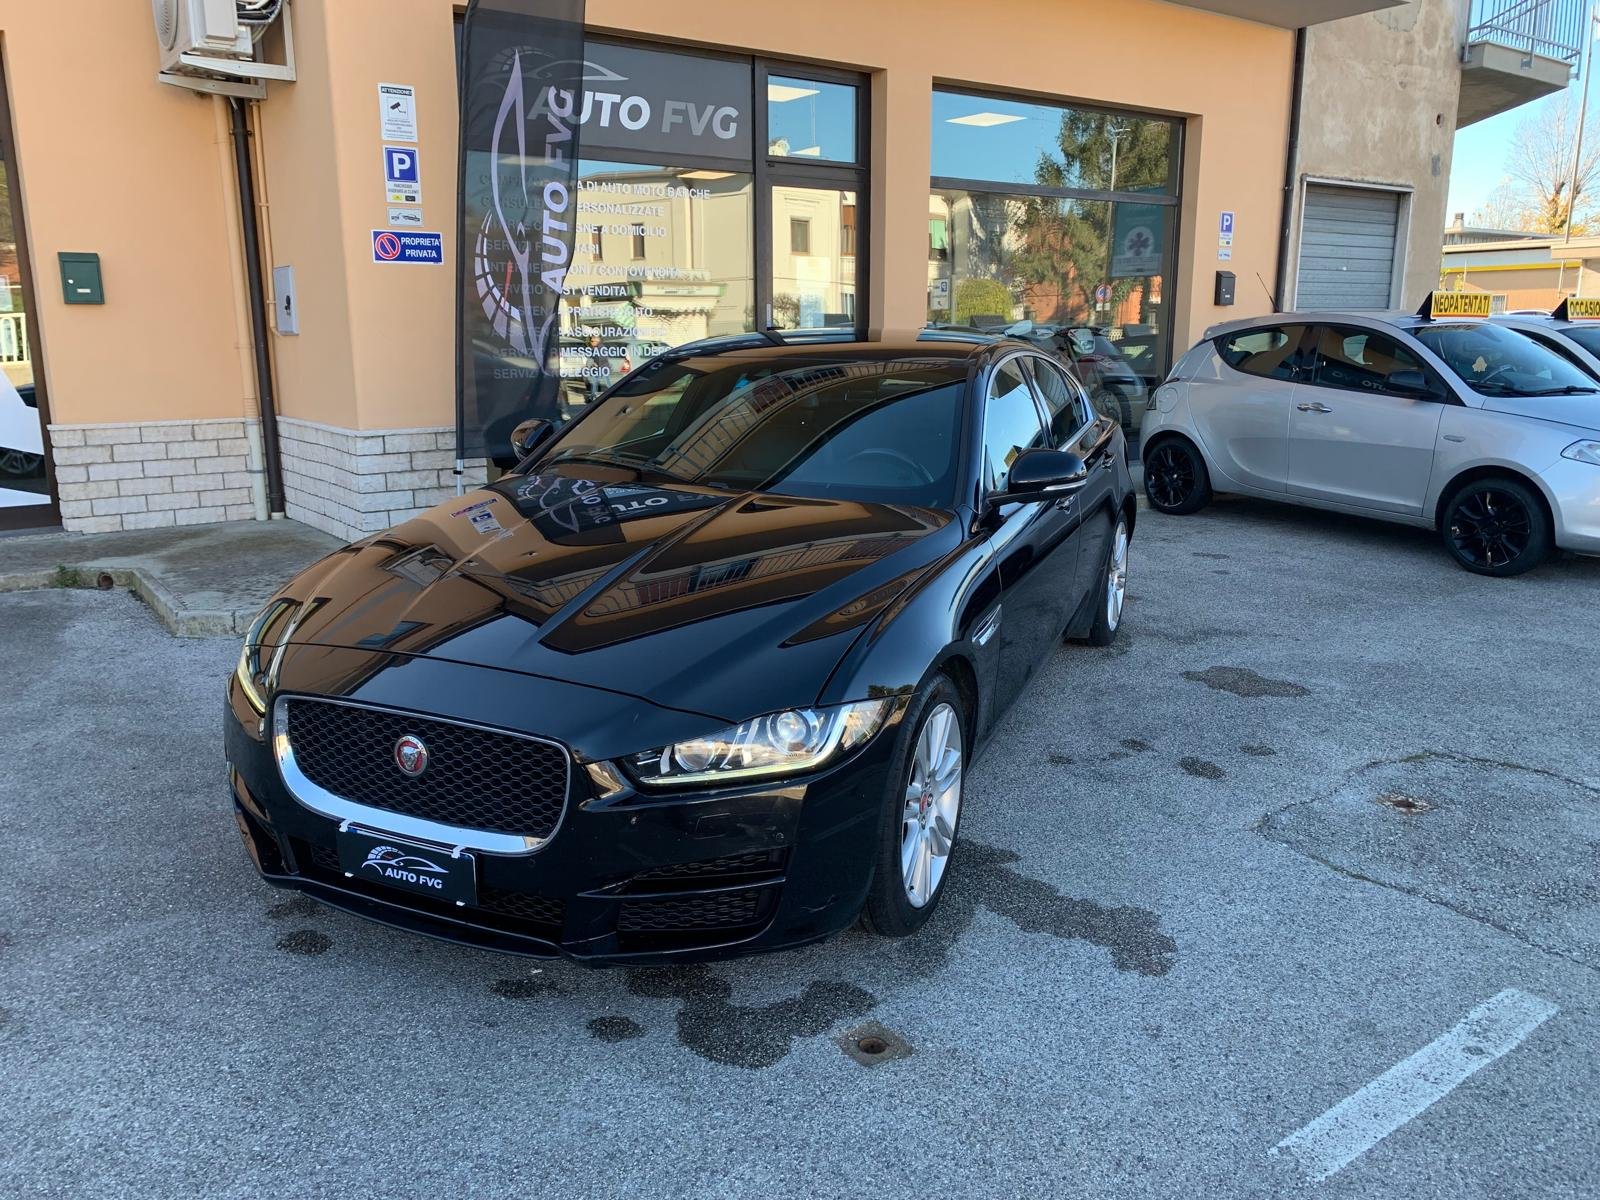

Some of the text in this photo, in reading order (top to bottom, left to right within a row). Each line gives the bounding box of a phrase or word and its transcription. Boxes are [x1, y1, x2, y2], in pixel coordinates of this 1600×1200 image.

[527, 87, 739, 140] AUTO FVG
[393, 153, 411, 178] P
[541, 85, 574, 295] AUTO FVG
[601, 182, 630, 194] AUTO
[634, 184, 665, 196] MOTO
[668, 187, 711, 200] BARCHE
[612, 224, 667, 238] DOMICILIO
[1223, 215, 1231, 230] P
[405, 249, 437, 259] PRIVATA
[581, 286, 627, 297] VENDITA
[1433, 294, 1491, 314] NEOPATENTATI
[384, 867, 443, 890] AUTO FVG
